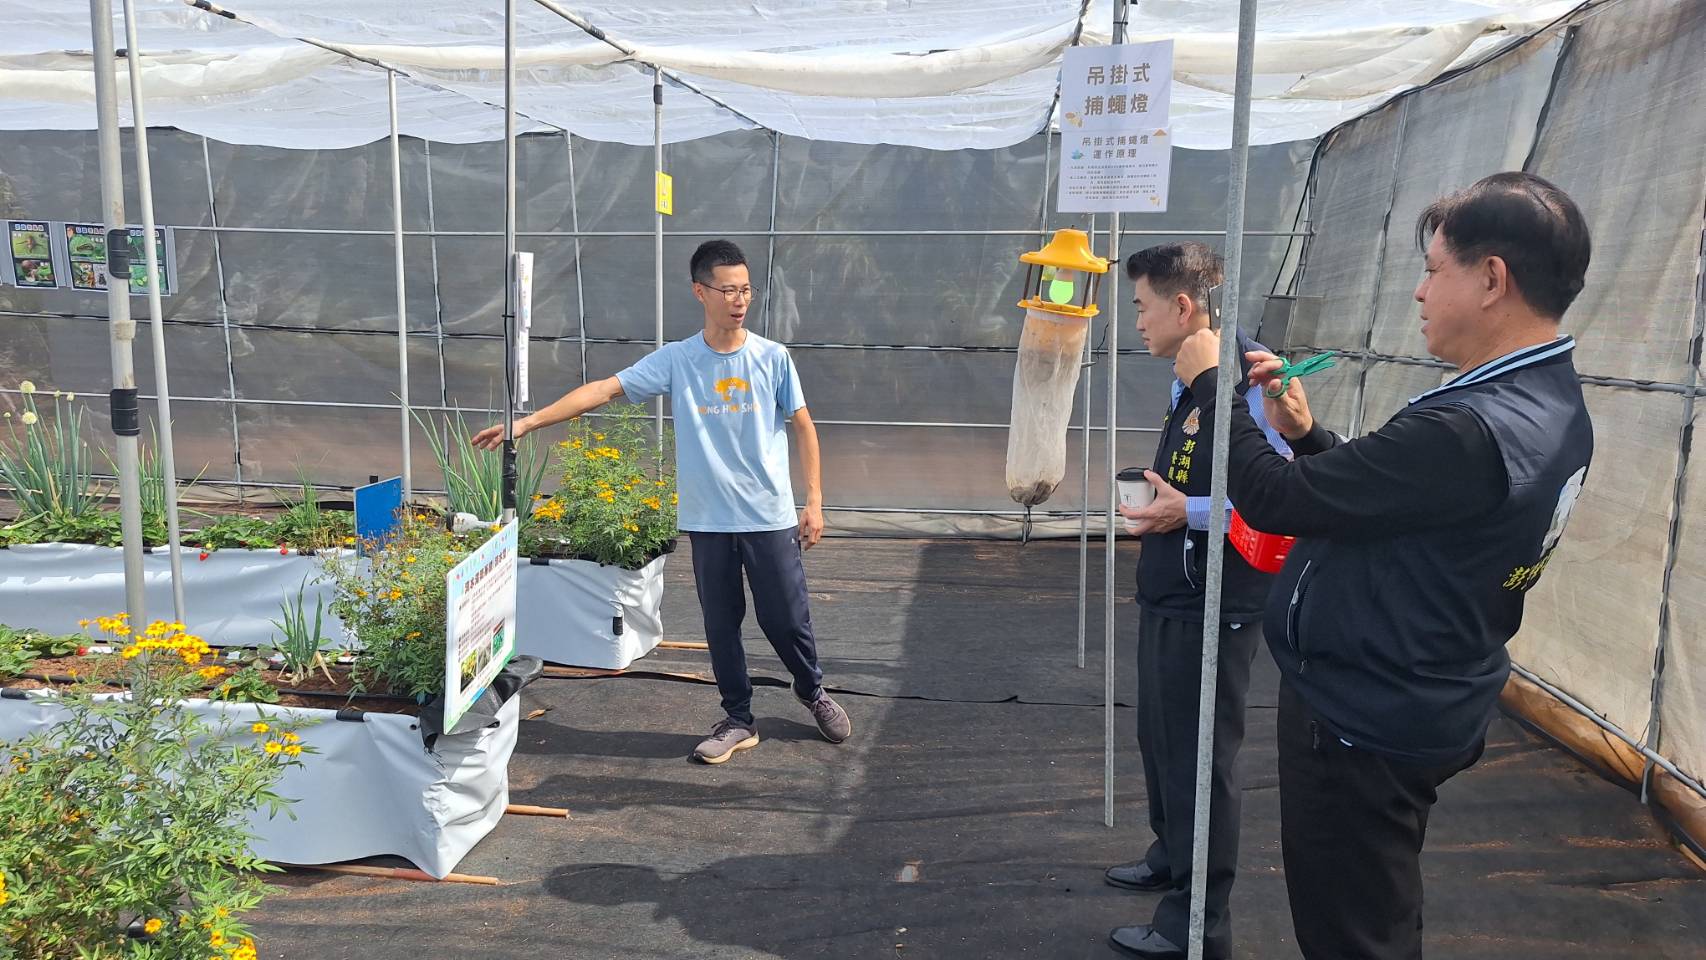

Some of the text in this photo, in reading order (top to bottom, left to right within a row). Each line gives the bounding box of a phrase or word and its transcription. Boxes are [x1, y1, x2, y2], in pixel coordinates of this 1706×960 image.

[1087, 63, 1151, 86] 吊掛式
[1084, 93, 1149, 116] 捕蠅燈
[1082, 135, 1149, 147] 吊掛式捕蠅燈
[1093, 148, 1137, 160] 運作原理
